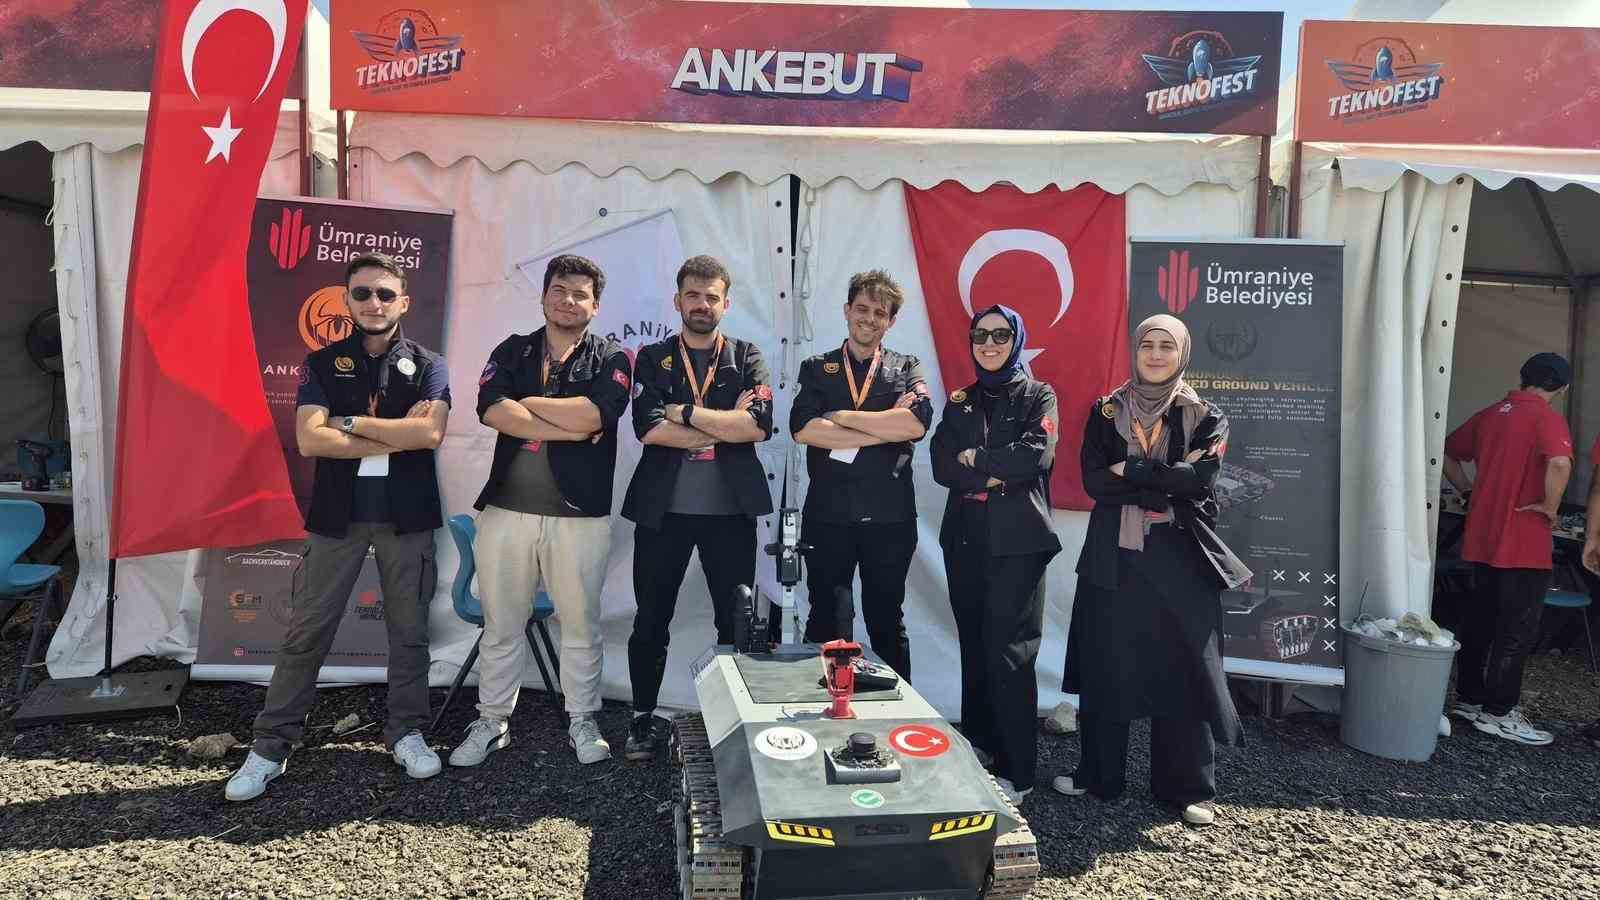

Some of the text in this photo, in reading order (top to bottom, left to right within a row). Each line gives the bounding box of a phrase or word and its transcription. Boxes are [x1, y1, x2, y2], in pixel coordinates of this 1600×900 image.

[355, 48, 462, 87] TEKNOFEST
[670, 47, 897, 96] ANKEBUT
[1145, 68, 1258, 114] TEKNOFEST
[1327, 76, 1440, 117] TEKNOFEST
[318, 222, 423, 253] Ümraniye
[316, 245, 420, 269] Beleesi
[1206, 262, 1314, 290] Ümraniye
[1205, 286, 1313, 309] Belediyesi
[263, 364, 299, 376] ANK
[1212, 379, 1270, 391] GROUND
